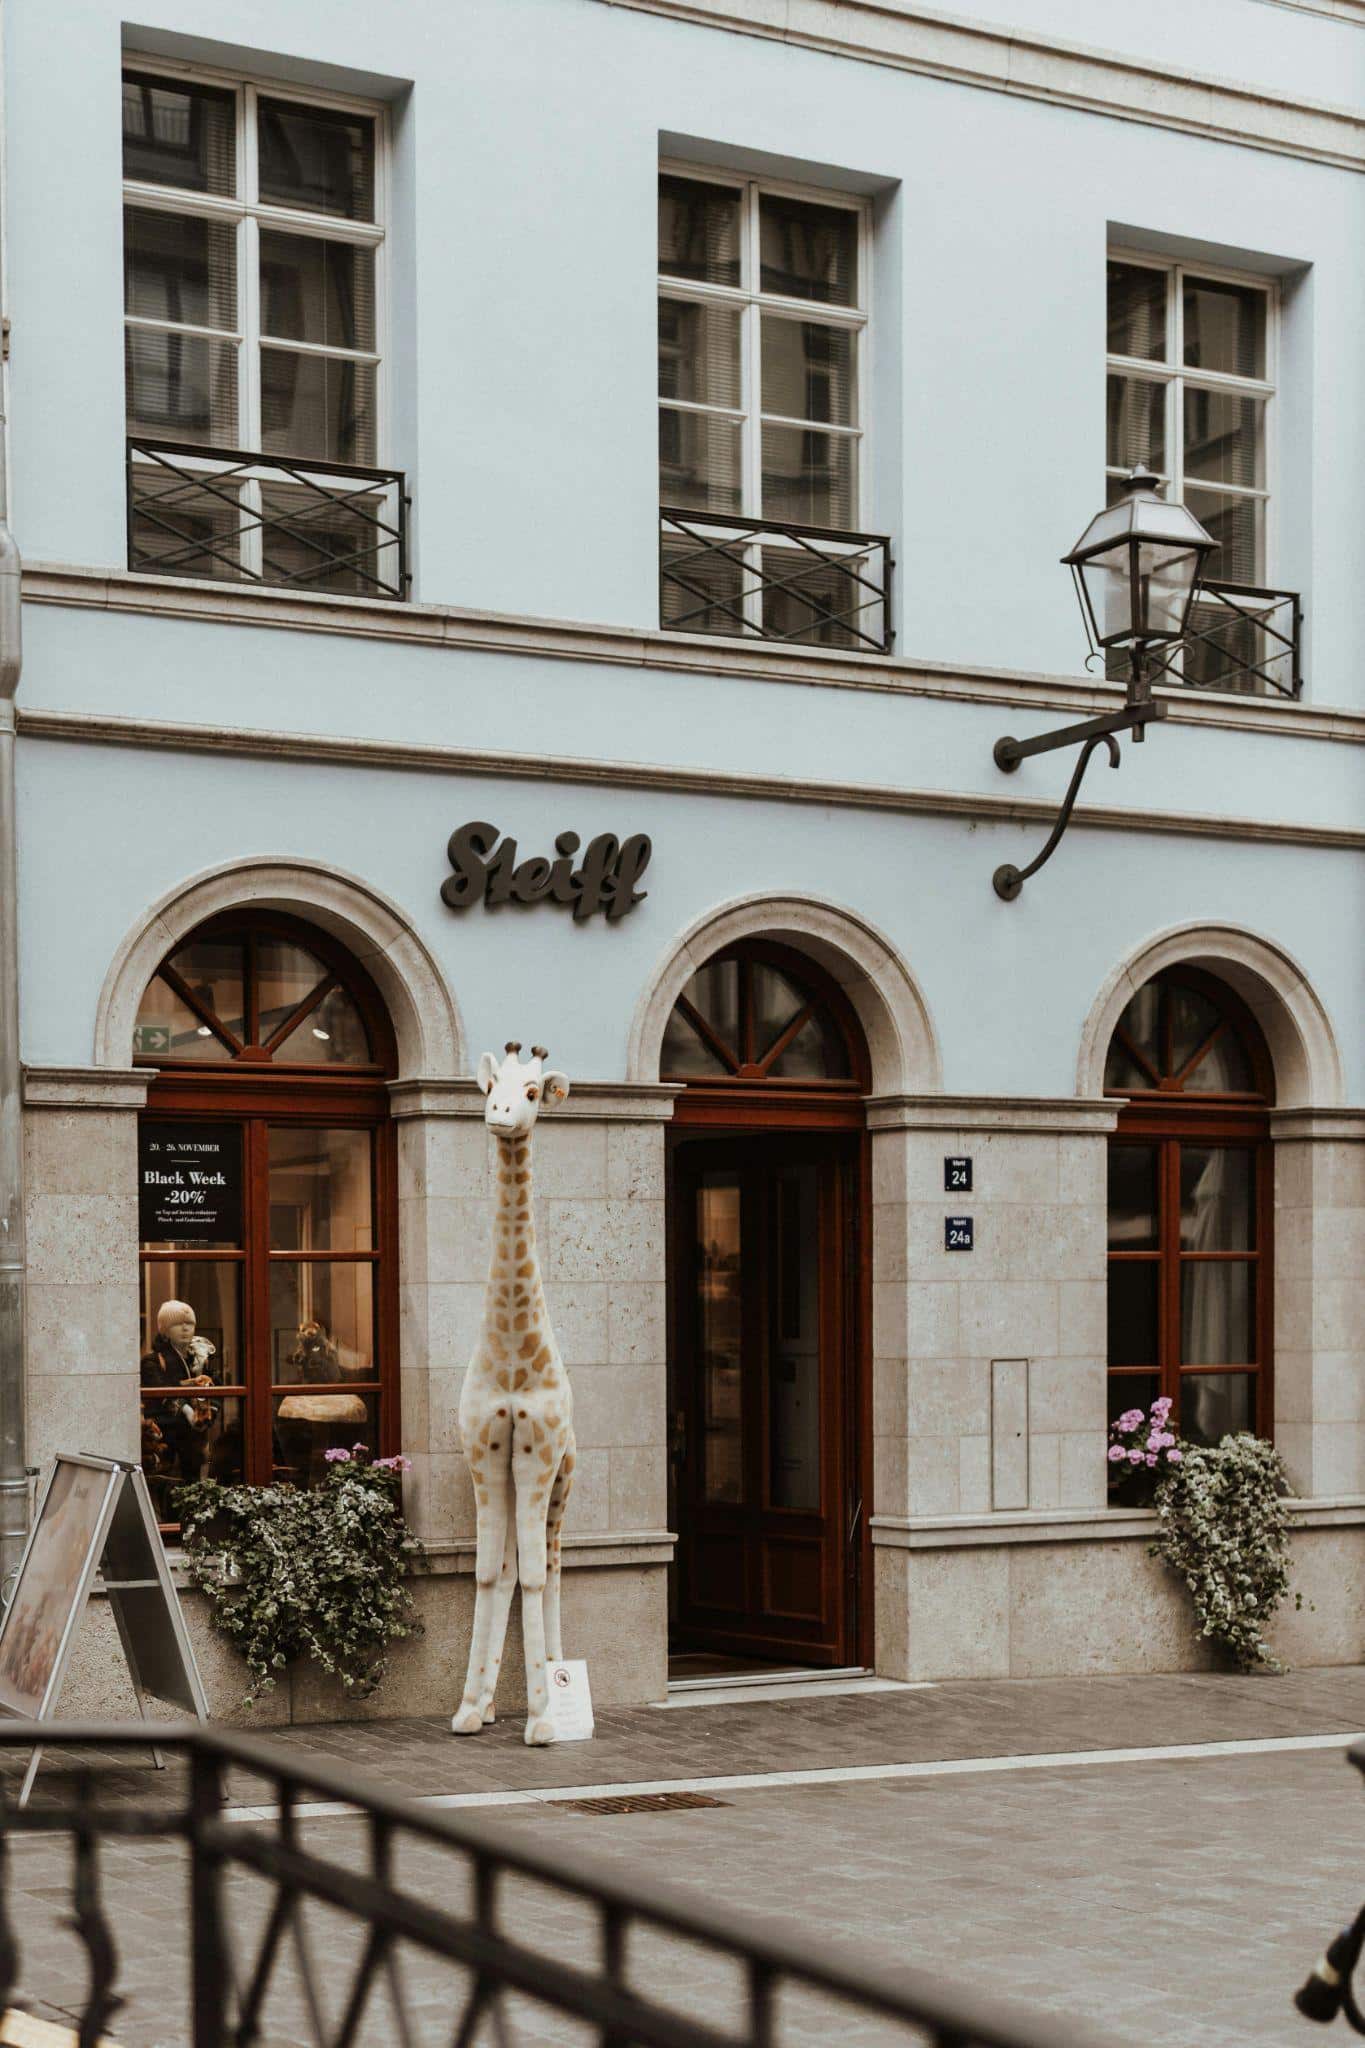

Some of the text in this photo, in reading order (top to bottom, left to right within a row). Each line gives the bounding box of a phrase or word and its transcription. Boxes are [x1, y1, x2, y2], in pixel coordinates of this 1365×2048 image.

[440, 821, 652, 921] Steiff
[178, 1143, 220, 1152] NOVEMBER
[144, 1170, 226, 1185] Black Week
[952, 1171, 967, 1185] 24
[950, 1230, 970, 1244] 24a
